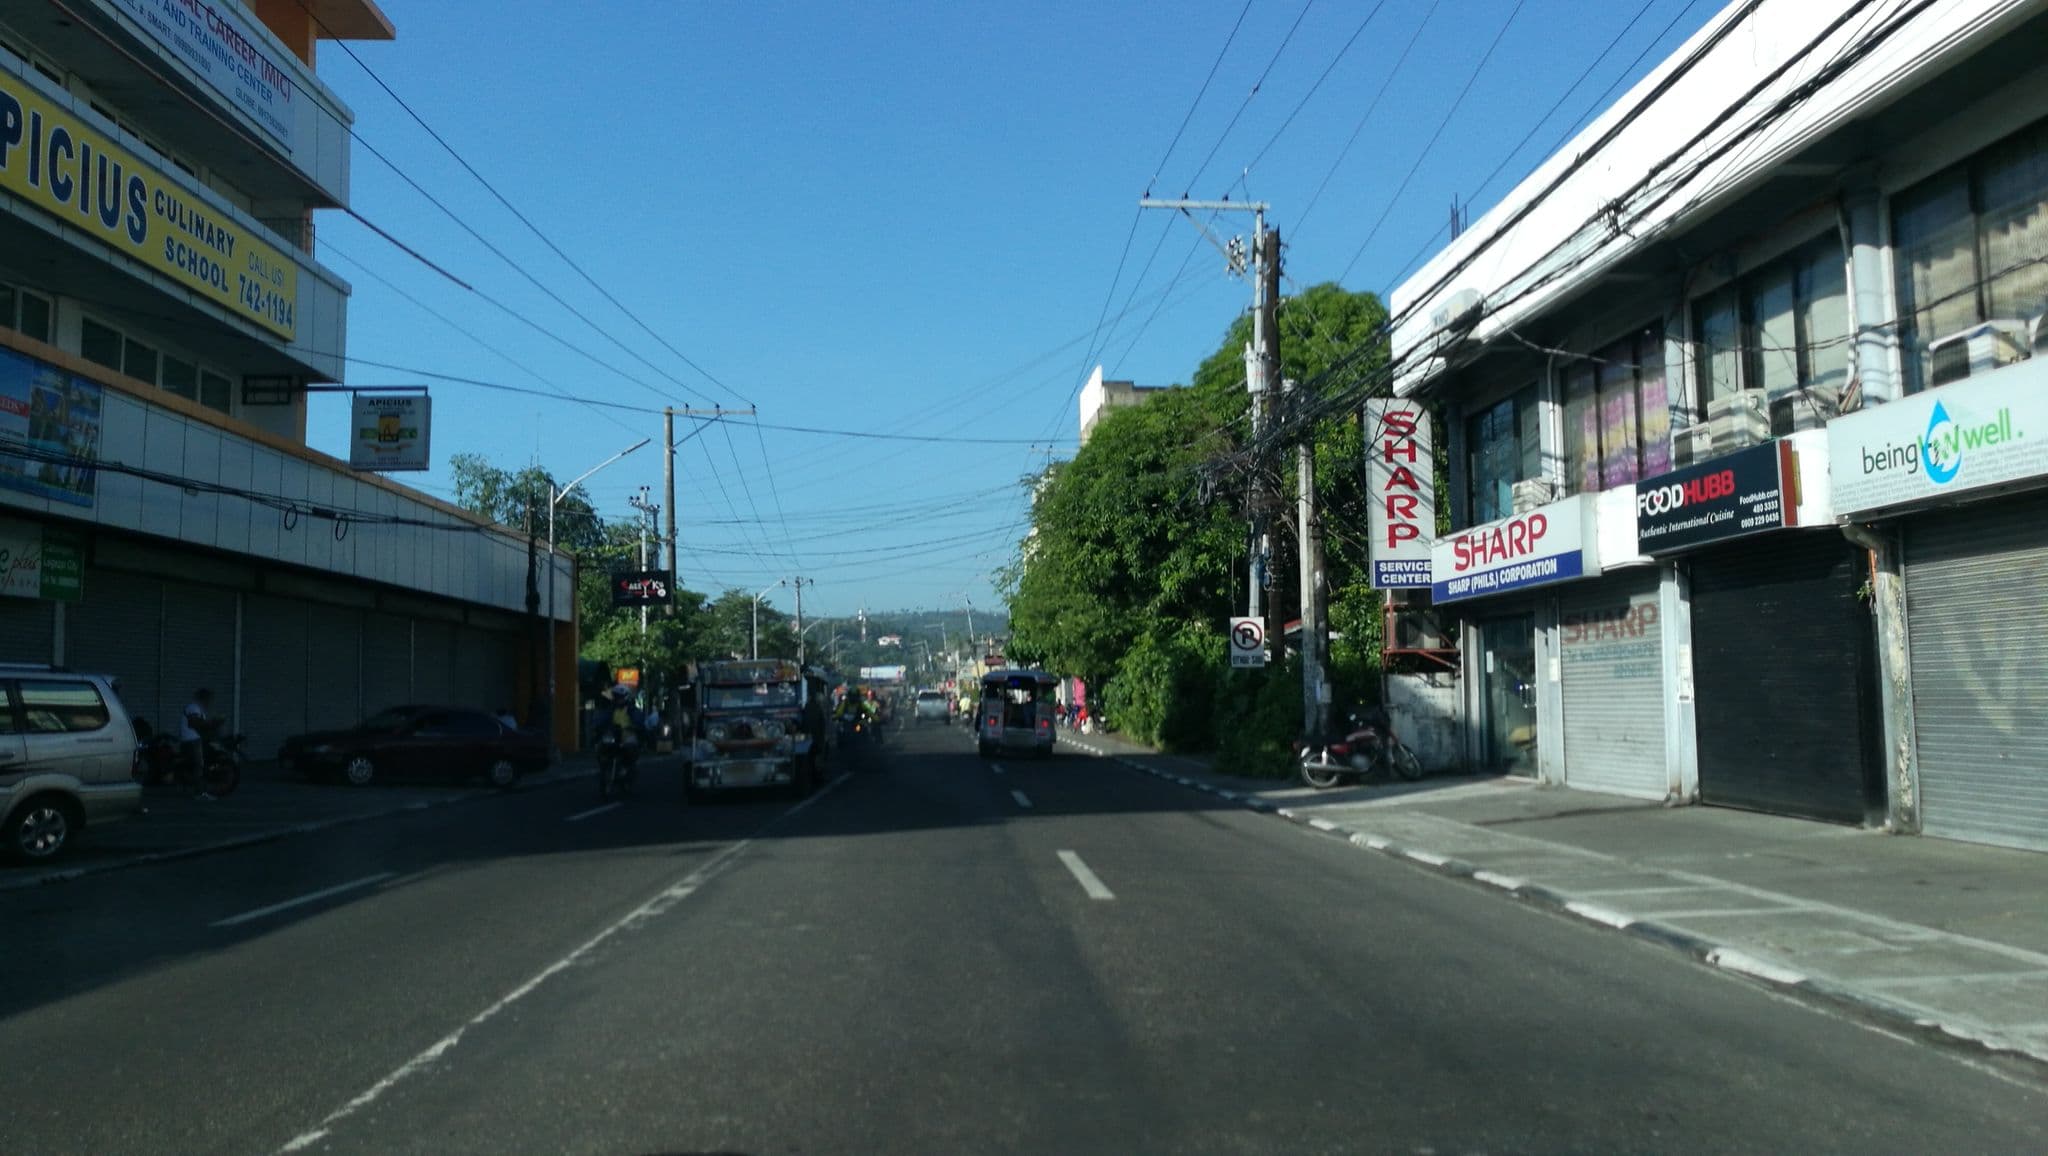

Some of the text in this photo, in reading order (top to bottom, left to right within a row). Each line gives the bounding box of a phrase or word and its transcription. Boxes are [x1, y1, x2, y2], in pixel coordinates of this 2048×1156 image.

[163, 0, 186, 28] AND
[188, 18, 235, 73] TRAINING
[237, 64, 273, 105] CENTER
[206, 6, 256, 69] CAREER
[155, 189, 235, 258] CULINARY
[165, 235, 229, 293] SCHOOL
[248, 251, 269, 280] CALL
[1383, 411, 1420, 549] SHARP
[1862, 442, 1918, 474] being
[1454, 513, 1548, 572] SHARP
[1638, 509, 1734, 541] Authentic International Cuisine
[1379, 561, 1432, 572] SERVICE
[1381, 573, 1431, 584] CENTER
[1448, 558, 1557, 595] SHARP (PHILS.) CORPORATION
